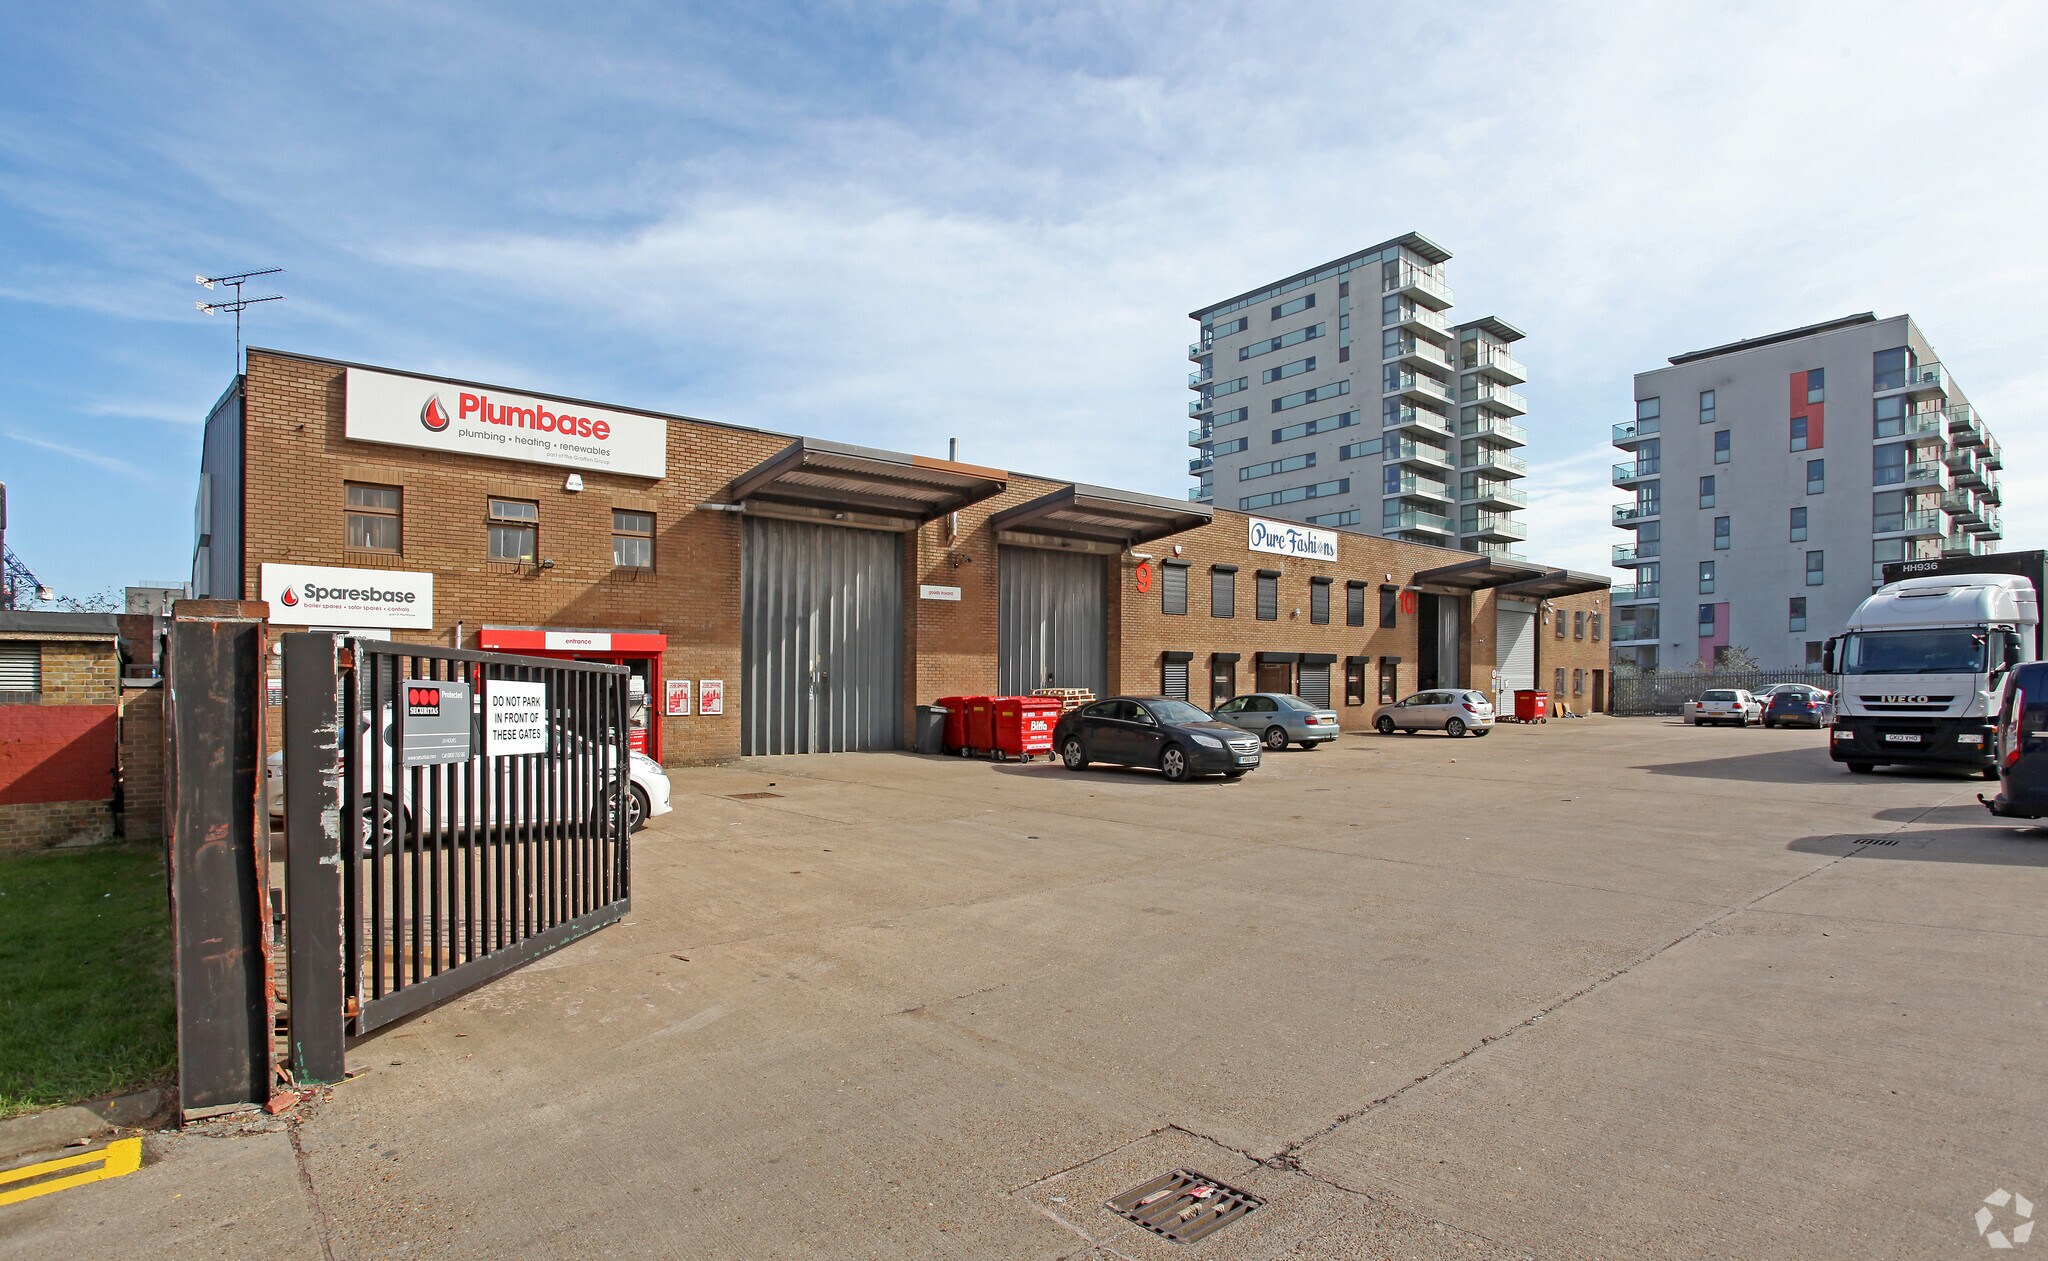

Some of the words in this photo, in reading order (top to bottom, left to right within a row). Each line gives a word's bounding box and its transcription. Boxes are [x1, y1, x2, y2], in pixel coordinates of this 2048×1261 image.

[459, 392, 611, 440] Plumbase
[458, 428, 506, 444] plumbing
[515, 435, 551, 449] heating
[560, 442, 611, 457] renewables
[573, 454, 594, 463] Grafton
[594, 457, 611, 465] Group
[1251, 522, 1286, 550] Pure
[1902, 562, 1938, 573] HH936
[1135, 562, 1152, 593] 9
[304, 583, 416, 604] Sparesbase
[1398, 591, 1415, 615] 10
[441, 690, 463, 699] Protected
[1881, 695, 1929, 704] IVECO
[493, 695, 504, 707] DO
[506, 696, 521, 707] NOT
[522, 696, 541, 707] PARK
[409, 706, 439, 715] SECURITAS
[494, 712, 503, 723] IN
[504, 712, 529, 723] FRONT
[529, 712, 539, 723] OF
[493, 729, 517, 740] THESE
[518, 728, 541, 740] GATES
